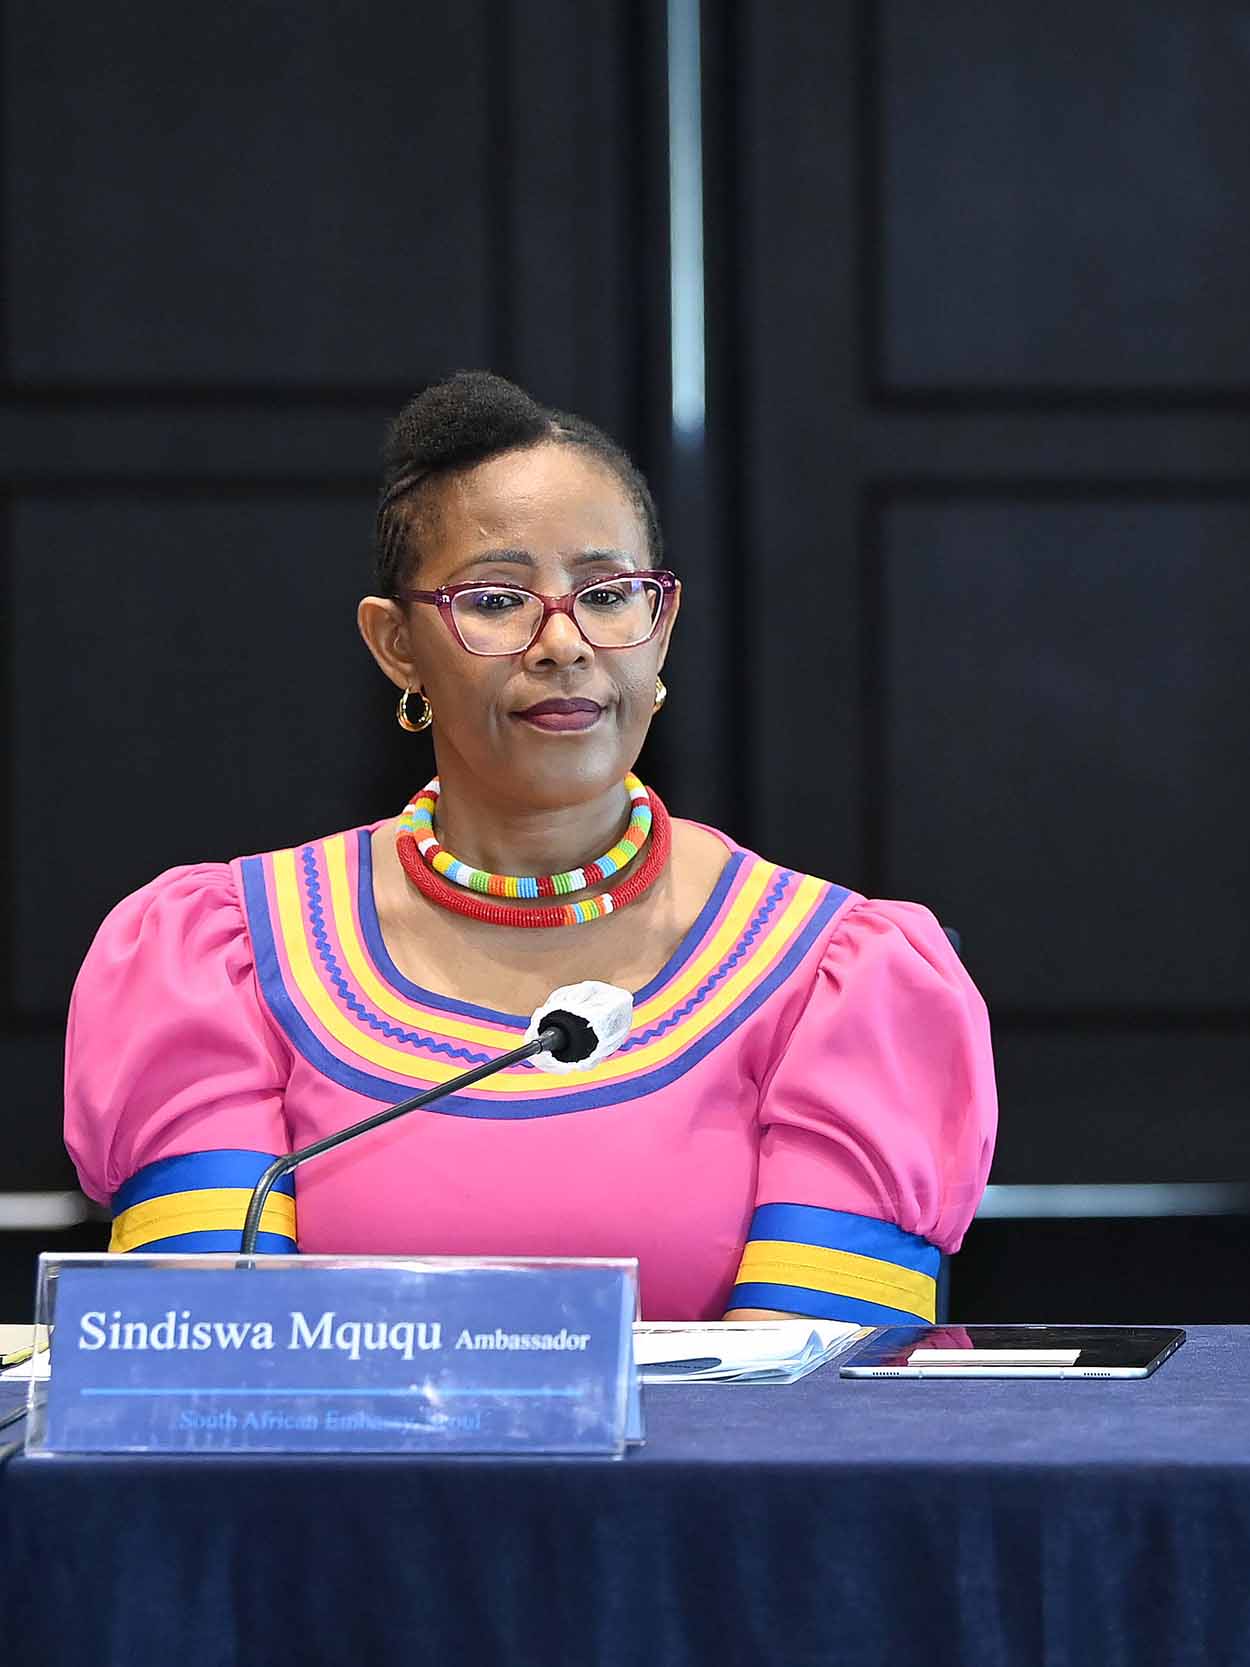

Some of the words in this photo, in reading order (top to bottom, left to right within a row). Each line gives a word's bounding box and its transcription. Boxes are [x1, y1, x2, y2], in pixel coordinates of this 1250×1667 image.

[78, 1310, 275, 1351] Sindiswa
[287, 1311, 442, 1361] Mququ
[455, 1328, 591, 1351] Ambassador
[179, 1409, 238, 1431] South
[243, 1409, 319, 1431] African
